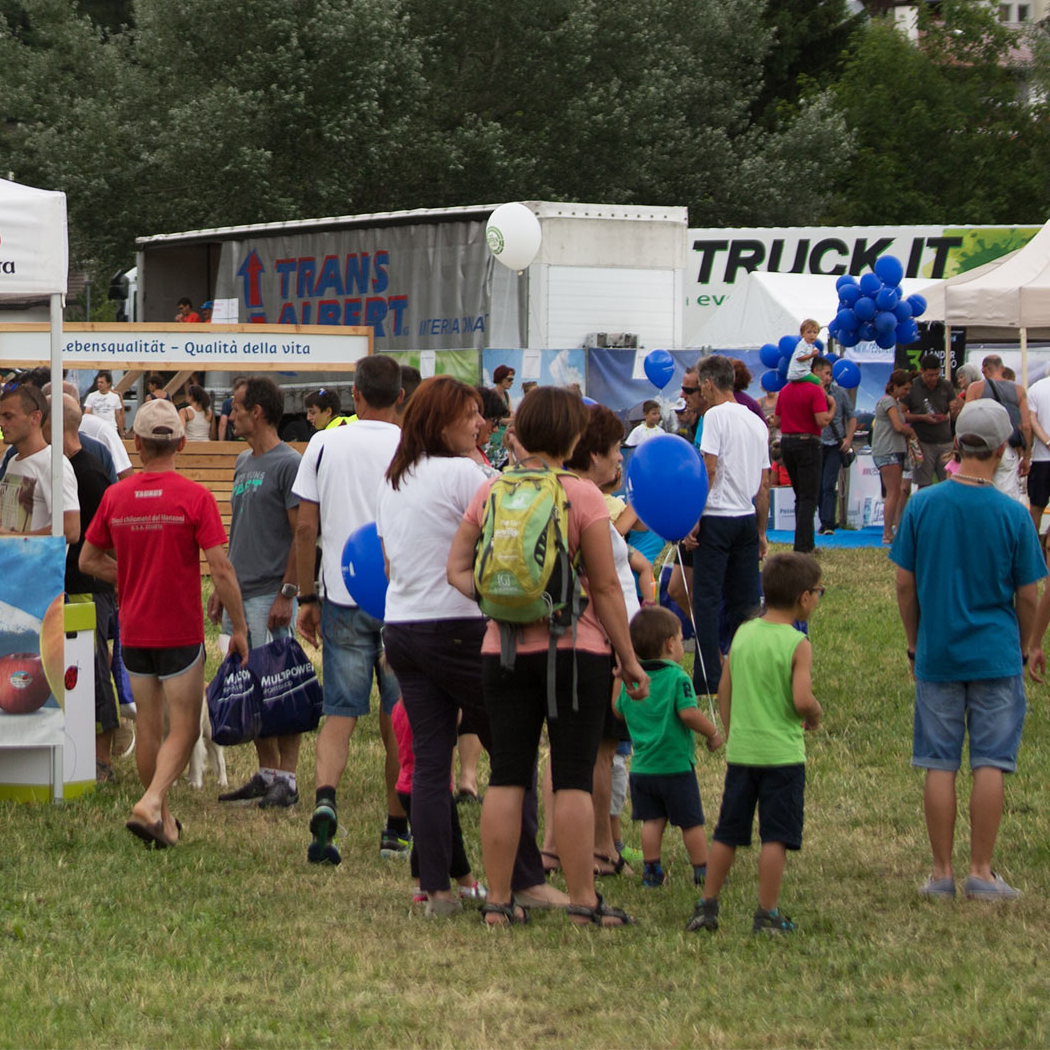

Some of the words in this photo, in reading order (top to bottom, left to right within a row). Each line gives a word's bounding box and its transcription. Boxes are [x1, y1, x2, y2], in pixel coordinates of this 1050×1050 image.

[274, 250, 390, 300] TRANS
[693, 237, 897, 285] TRUCK
[905, 236, 963, 279] IT
[62, 339, 166, 355] ebensqualität
[184, 340, 238, 356] Qualità
[243, 341, 277, 355] della
[283, 341, 311, 355] vita
